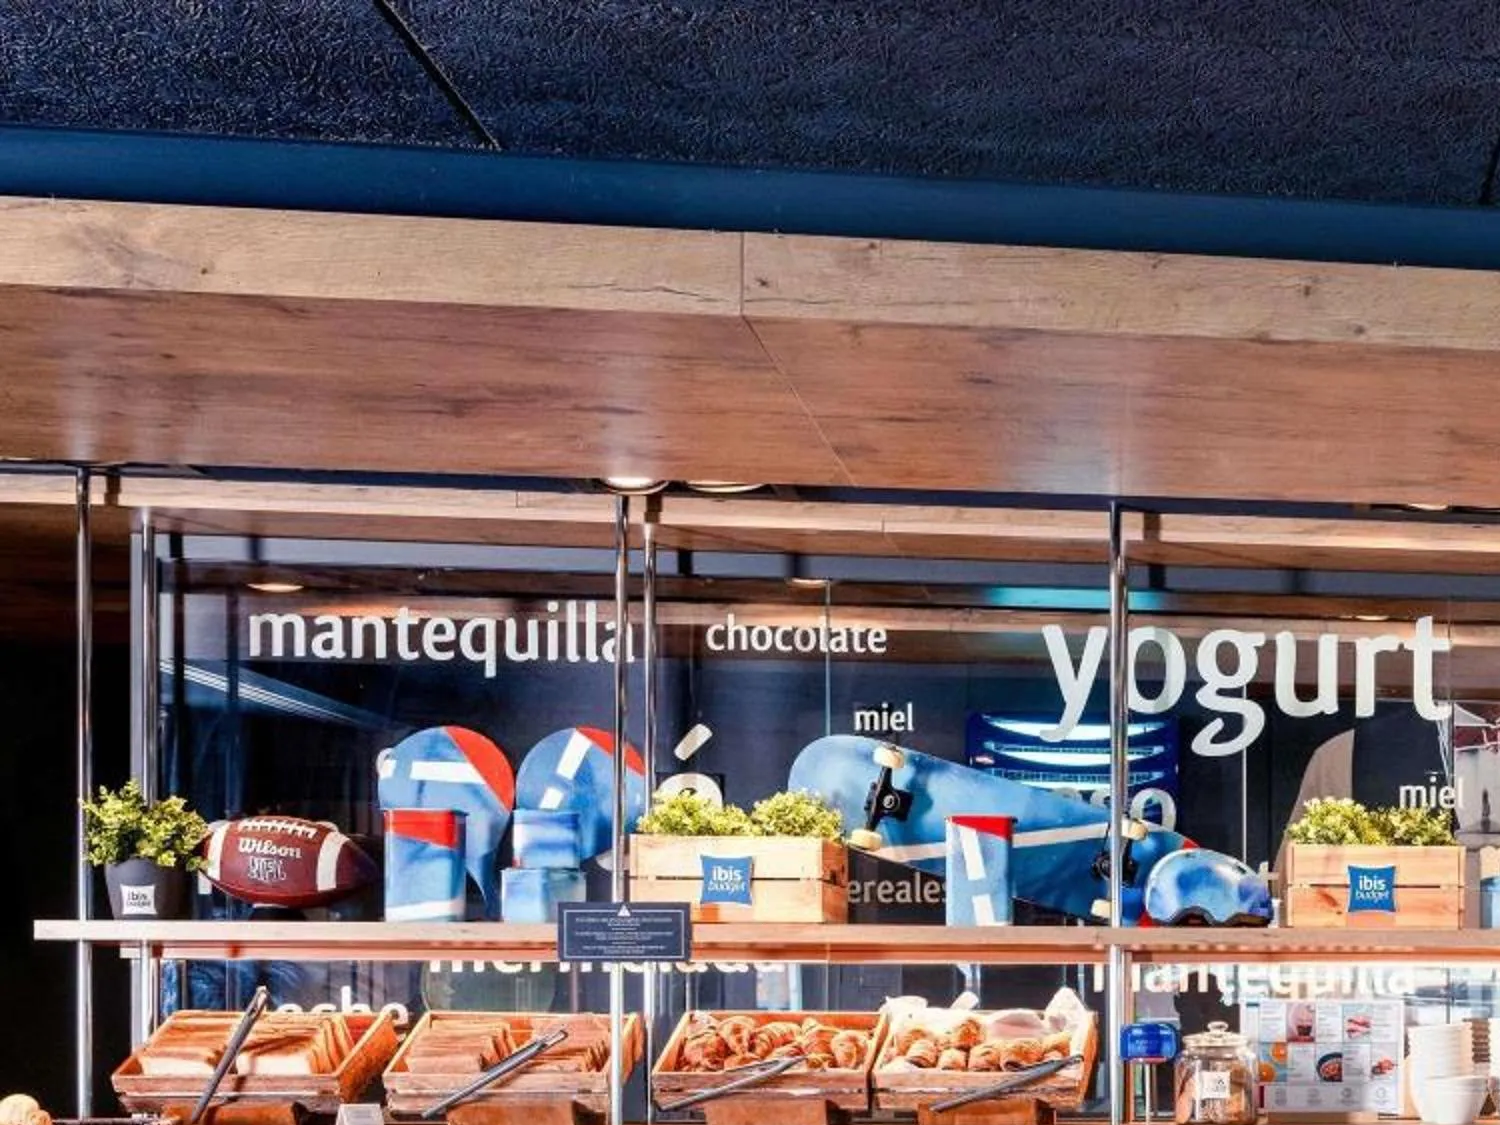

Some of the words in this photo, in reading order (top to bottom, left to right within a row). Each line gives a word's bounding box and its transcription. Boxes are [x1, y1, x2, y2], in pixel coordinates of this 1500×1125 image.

[249, 602, 635, 677] mantequilla
[706, 614, 888, 654] chocolate
[1040, 615, 1452, 757] yogurt
[854, 702, 914, 732] miel
[1401, 775, 1465, 810] miel
[238, 837, 303, 858] Wilson
[711, 864, 743, 881] ibis
[848, 872, 946, 904] ereale
[1359, 874, 1386, 891] ibis
